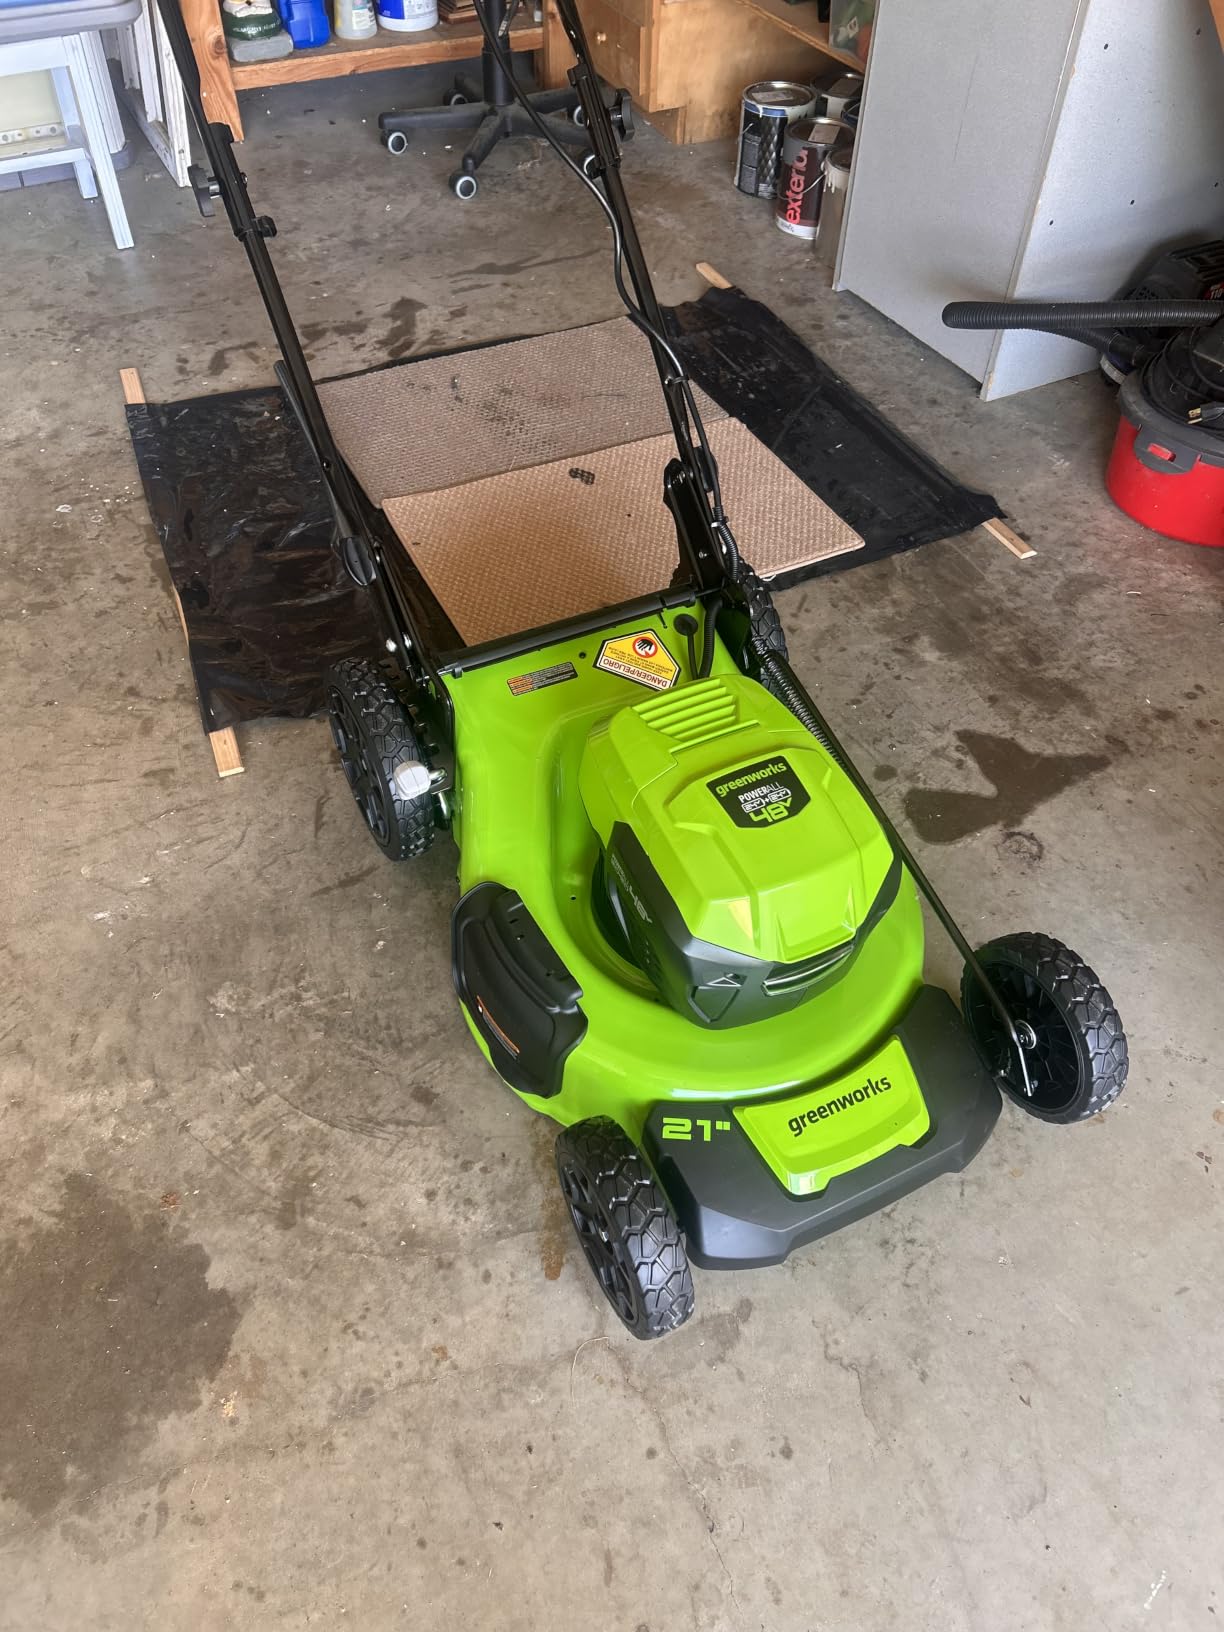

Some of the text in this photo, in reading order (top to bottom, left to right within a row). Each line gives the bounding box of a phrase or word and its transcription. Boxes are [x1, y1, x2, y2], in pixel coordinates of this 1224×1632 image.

[603, 658, 668, 688] DANGER/PELIGRO
[715, 762, 787, 797] greenworks
[738, 782, 785, 803] POWERALL
[749, 797, 792, 822] 48V
[788, 1076, 892, 1137] greenworks
[661, 1117, 731, 1142] 21"
